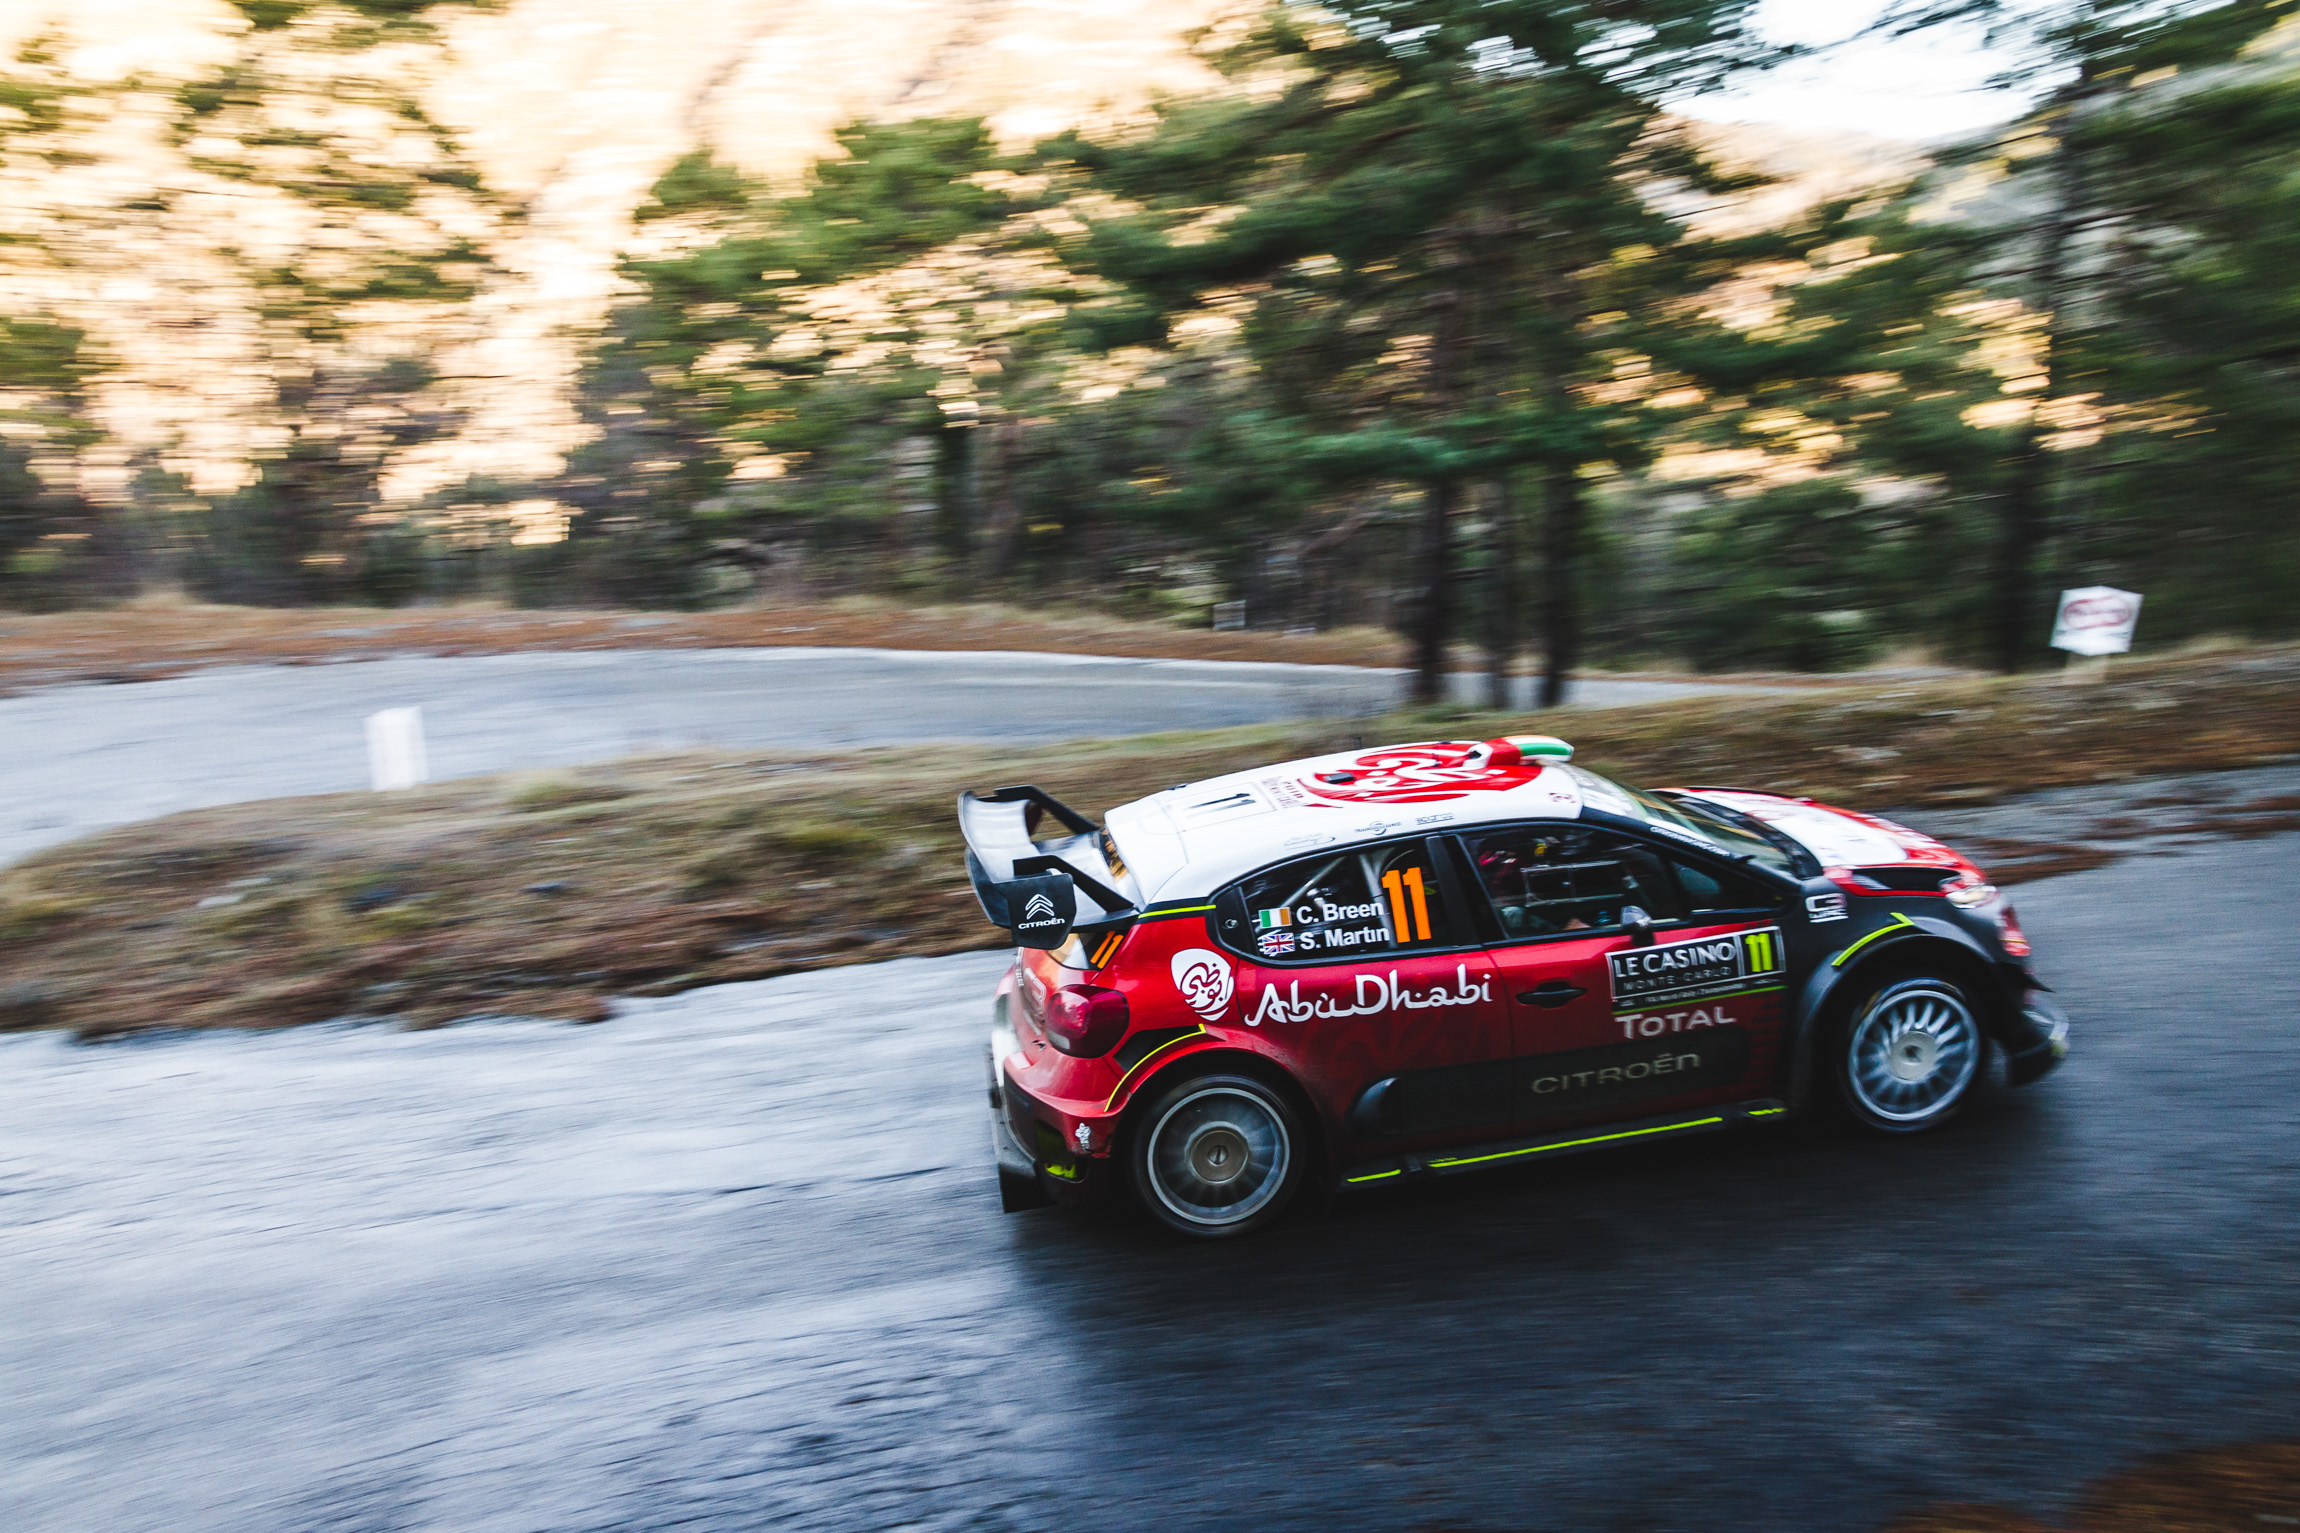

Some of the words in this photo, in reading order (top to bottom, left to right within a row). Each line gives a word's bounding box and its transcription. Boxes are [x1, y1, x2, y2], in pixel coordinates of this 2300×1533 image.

[1296, 905, 1319, 924] C.
[1322, 902, 1385, 922] Breen
[1381, 866, 1432, 944] 11
[1090, 930, 1124, 969] 11
[1300, 932, 1321, 950] S.
[1324, 926, 1390, 948] Martin
[1613, 957, 1641, 978] LE
[1642, 942, 1737, 973] CASINO
[1744, 932, 1774, 973] 11
[1614, 1006, 1737, 1040] TOTAL
